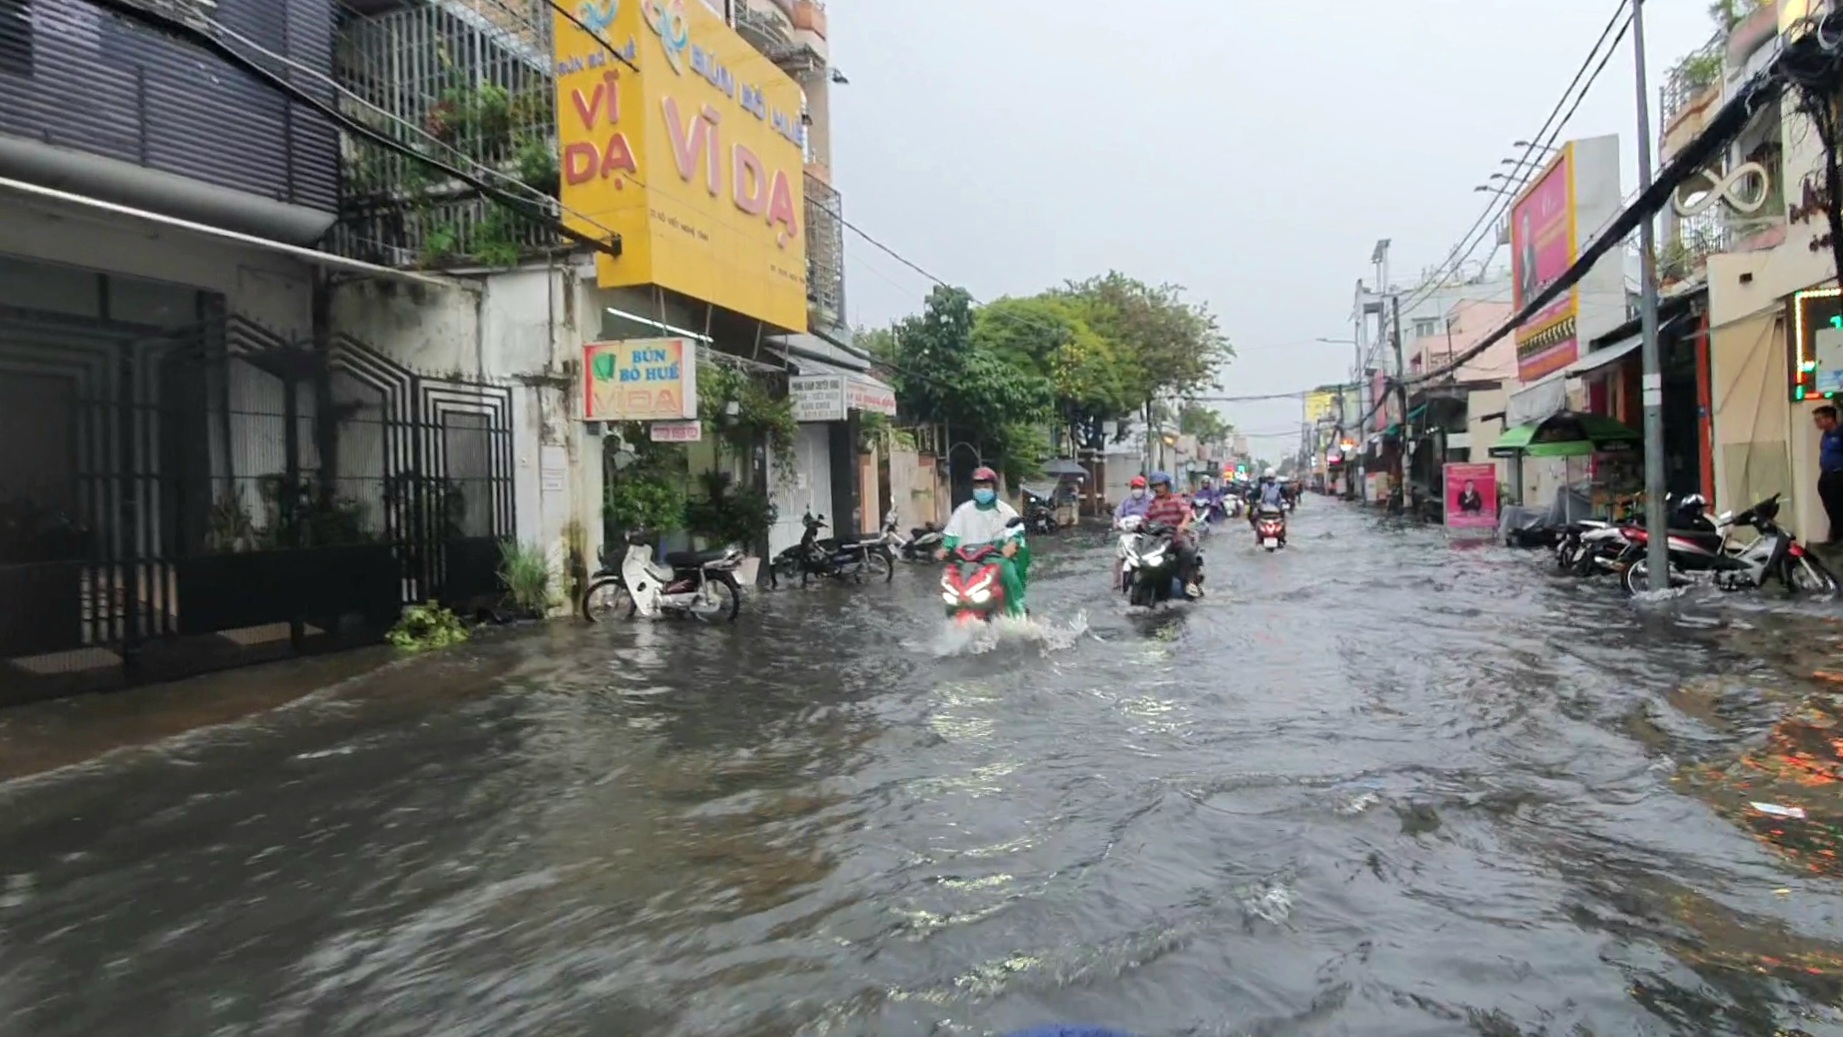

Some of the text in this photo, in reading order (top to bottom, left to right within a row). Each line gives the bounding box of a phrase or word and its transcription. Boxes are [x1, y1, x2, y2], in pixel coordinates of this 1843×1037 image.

[690, 43, 735, 99] BÚN
[565, 133, 637, 190] DẠ
[732, 143, 797, 249] DẠ
[632, 346, 666, 363] BÚN
[645, 361, 679, 381] HUẾ
